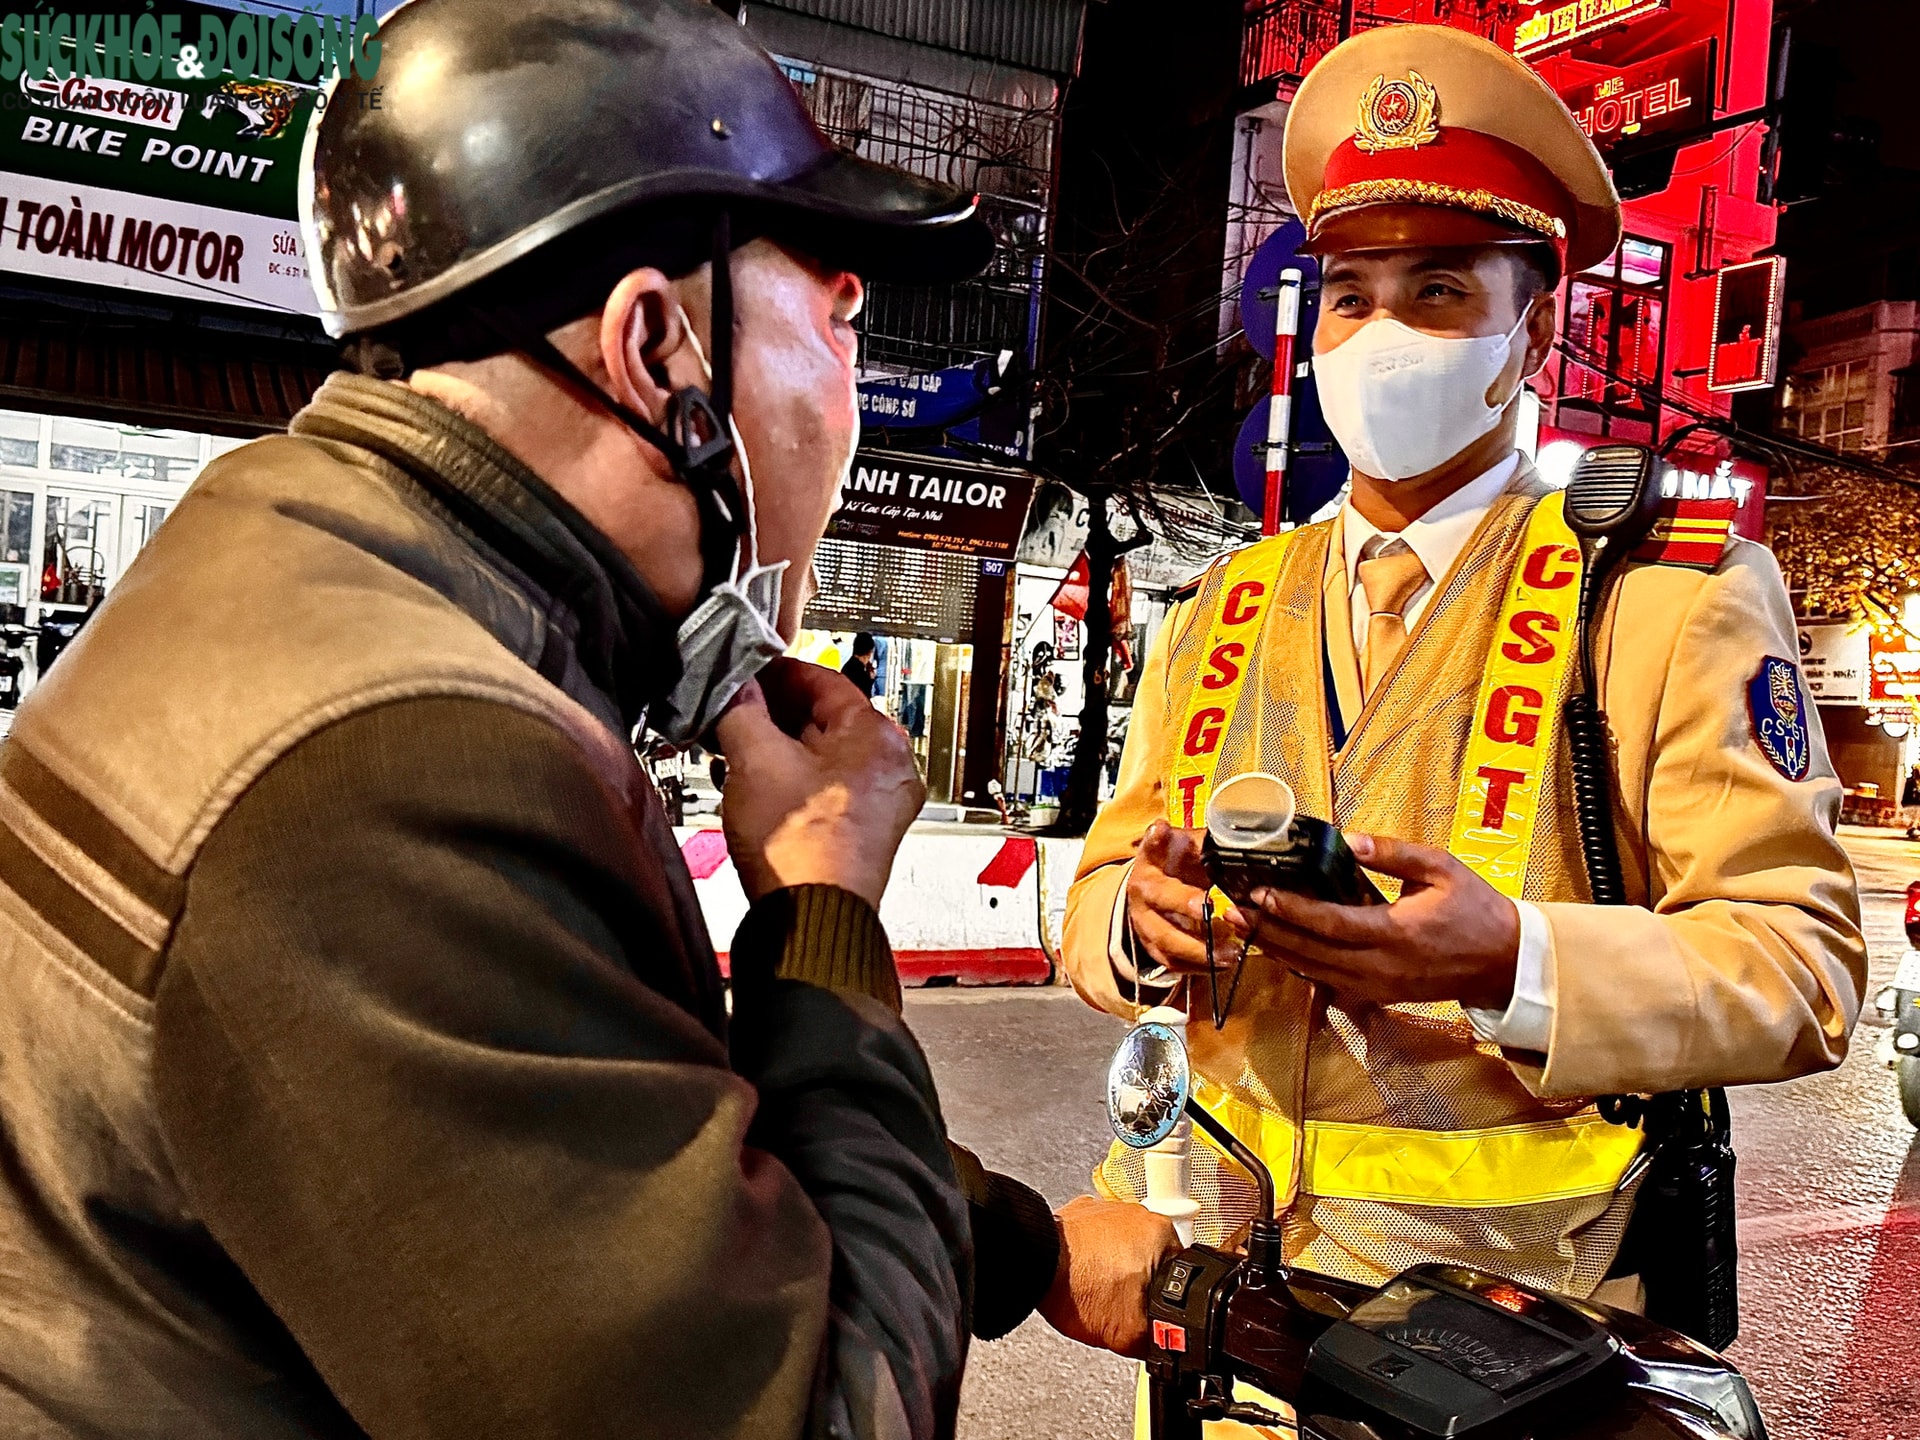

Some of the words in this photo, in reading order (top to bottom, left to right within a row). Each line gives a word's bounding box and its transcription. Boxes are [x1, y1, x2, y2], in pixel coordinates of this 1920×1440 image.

[1572, 78, 1691, 138] HOTEL
[21, 116, 127, 157] BIKE
[141, 138, 274, 183] POINT
[17, 196, 114, 263] TOÀN
[118, 217, 244, 284] MOTOR
[908, 473, 1007, 510] TAILOR
[985, 561, 1003, 574] 507
[1178, 580, 1265, 829] CSGT
[1474, 544, 1580, 830] CSGT
